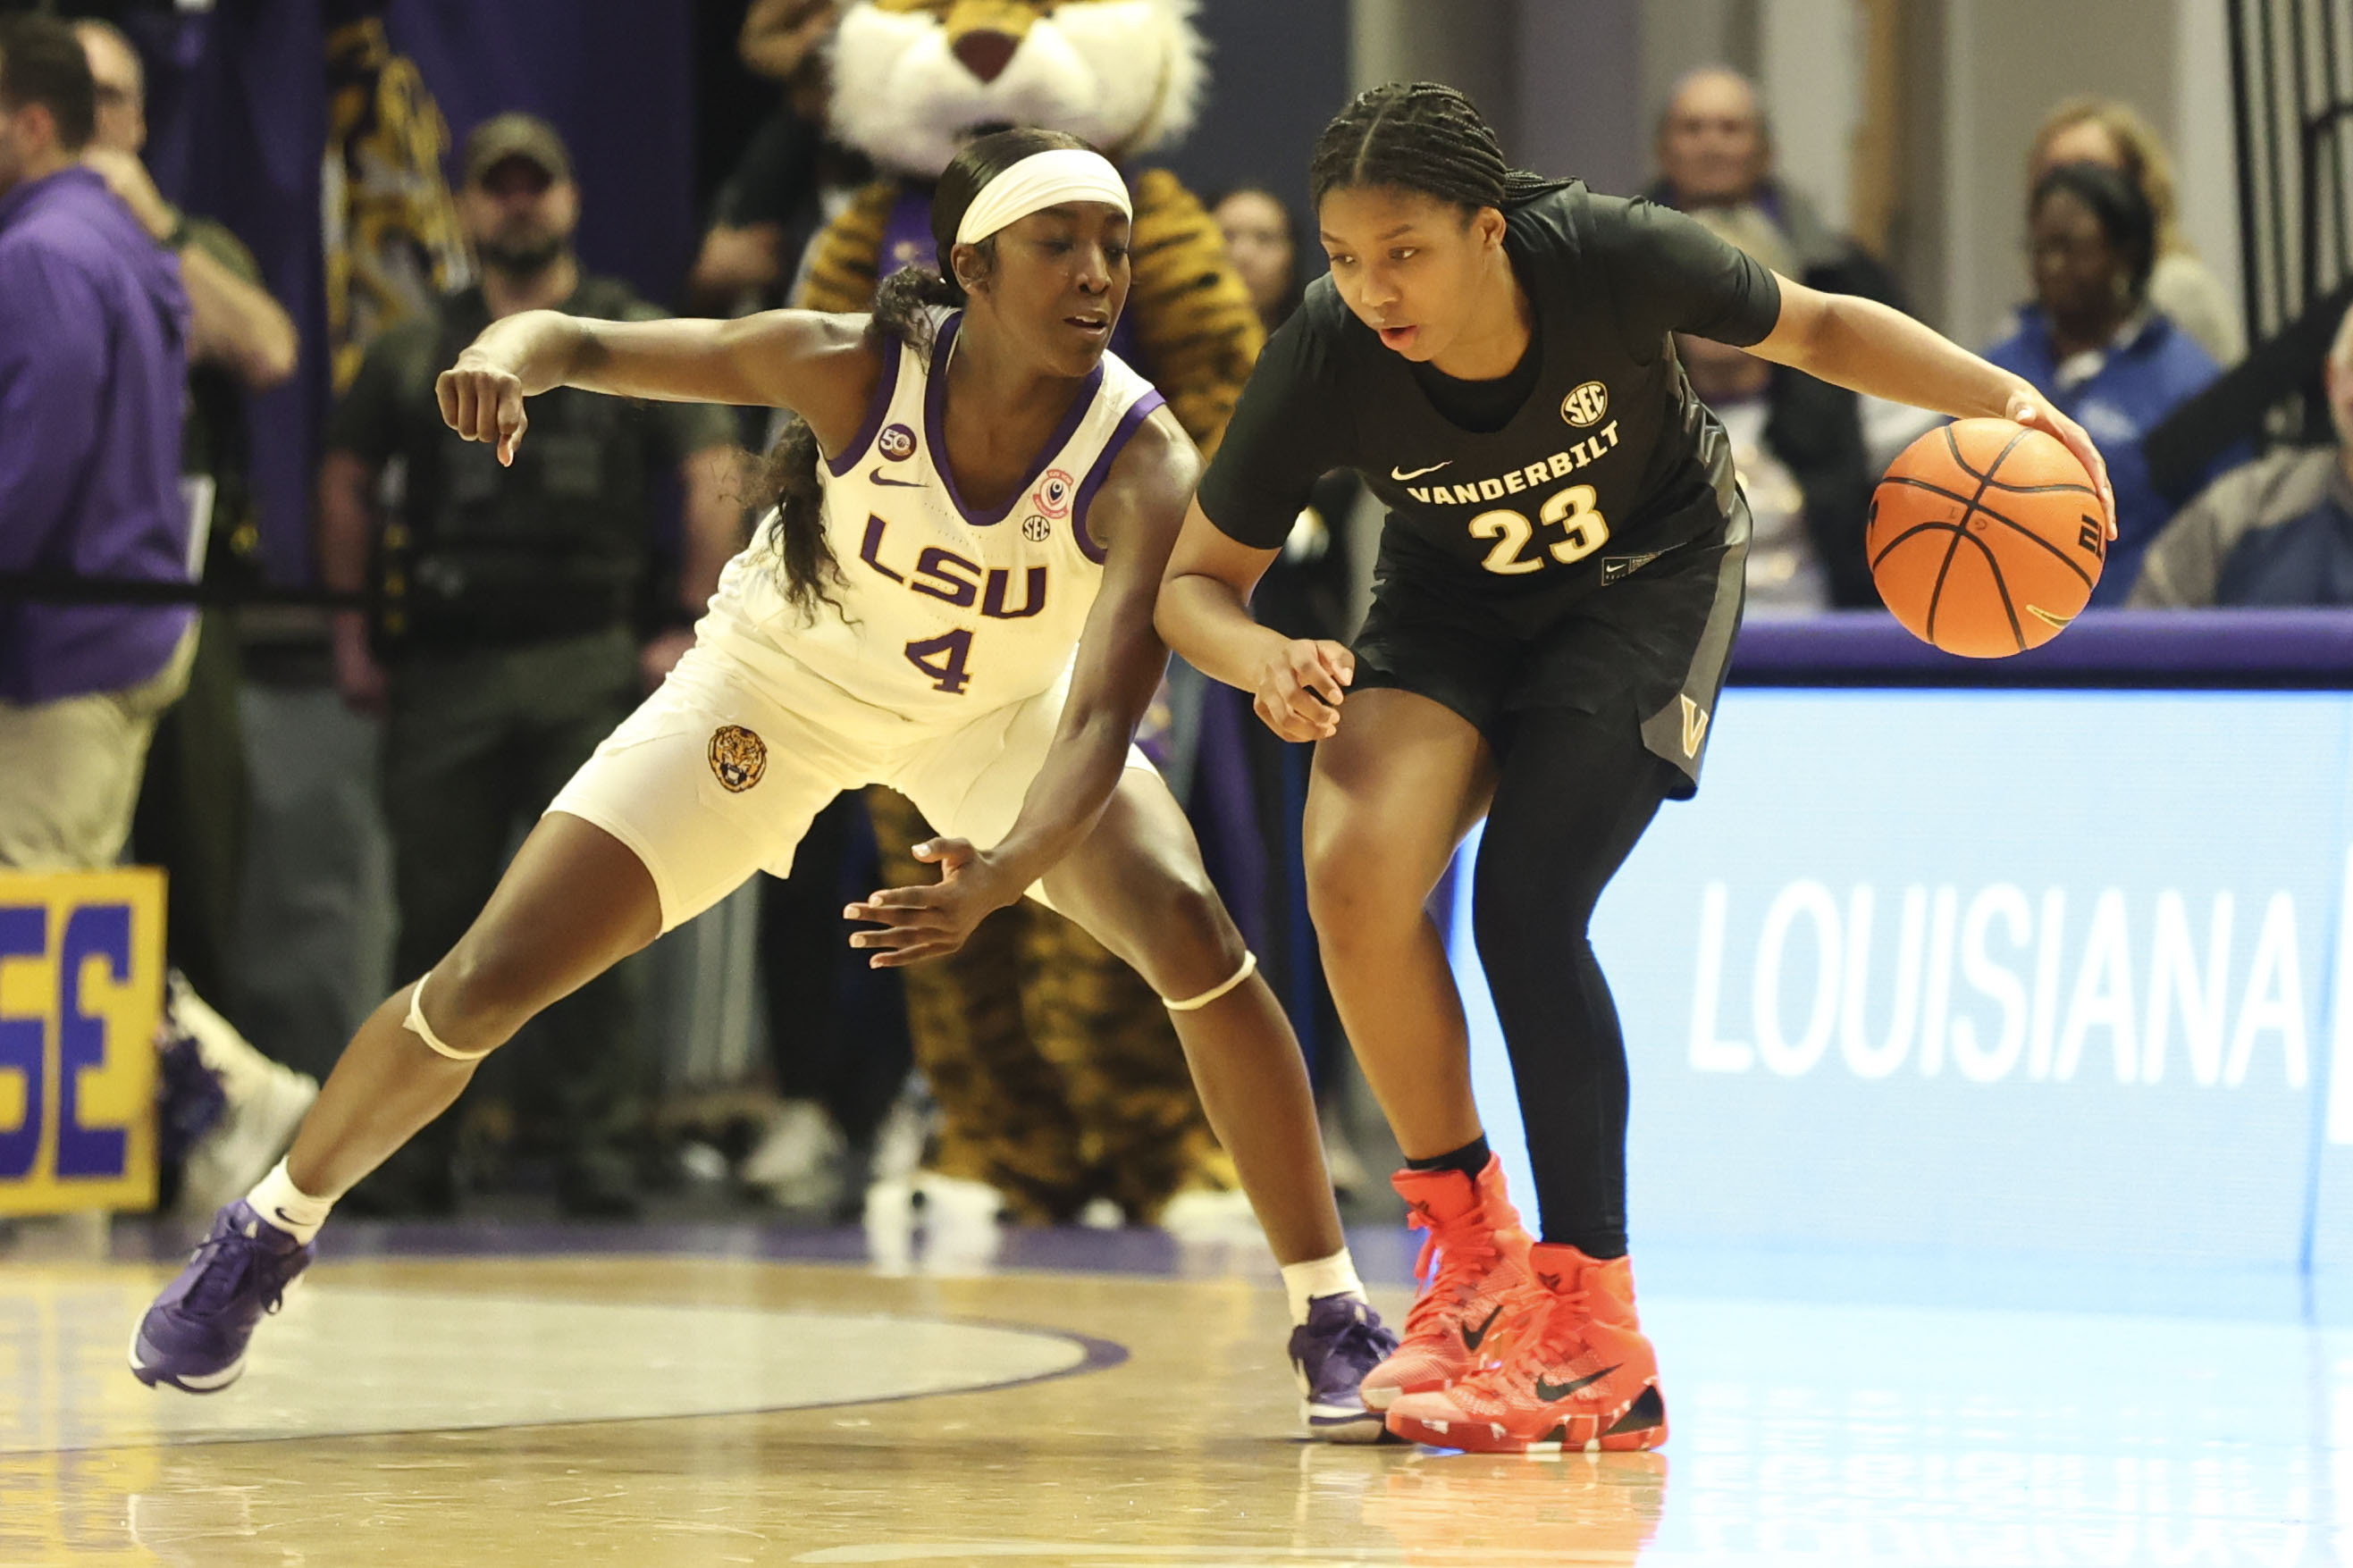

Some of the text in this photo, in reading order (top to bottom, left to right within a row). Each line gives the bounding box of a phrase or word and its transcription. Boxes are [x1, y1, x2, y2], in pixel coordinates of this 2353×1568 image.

[1564, 383, 1605, 424] SEC
[1407, 420, 1618, 504] VANDERBILT
[860, 512, 1048, 619] LSU
[1023, 516, 1050, 541] SEC
[1468, 484, 1609, 574] 23
[904, 628, 972, 695] 4
[1680, 693, 1709, 759] V
[1687, 877, 2308, 1086] LOUISIANA
